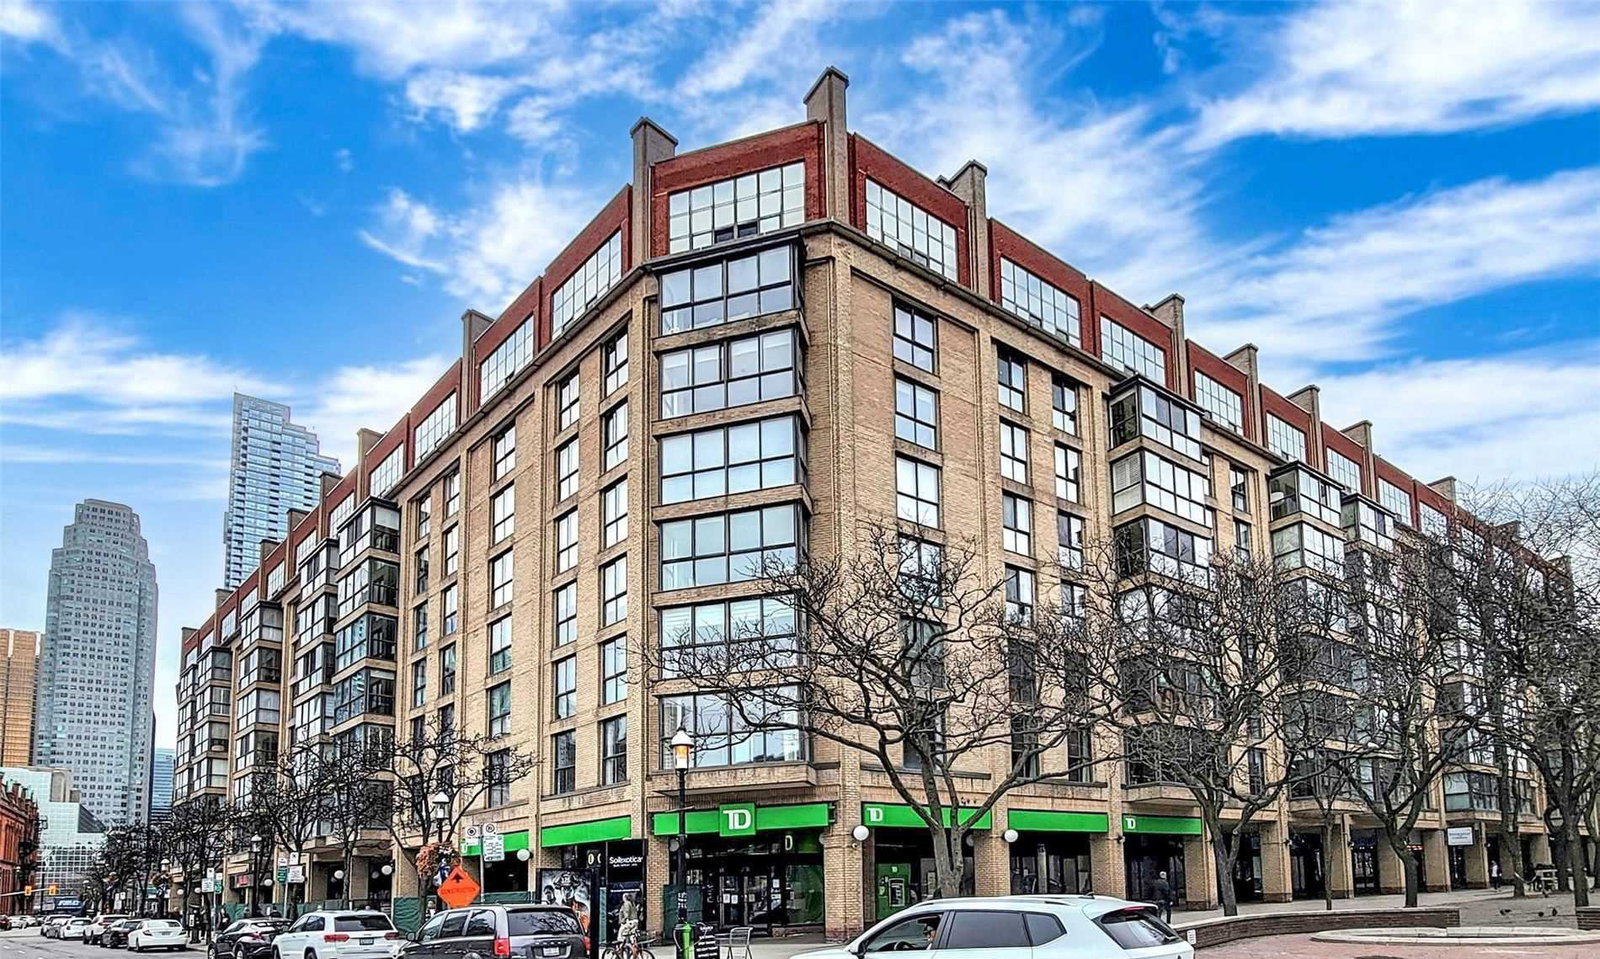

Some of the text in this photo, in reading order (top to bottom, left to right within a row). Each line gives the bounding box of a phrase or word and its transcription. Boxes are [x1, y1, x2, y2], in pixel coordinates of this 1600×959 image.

[723, 809, 752, 830] TD
[866, 807, 884, 822] TD
[1125, 818, 1136, 829] TD
